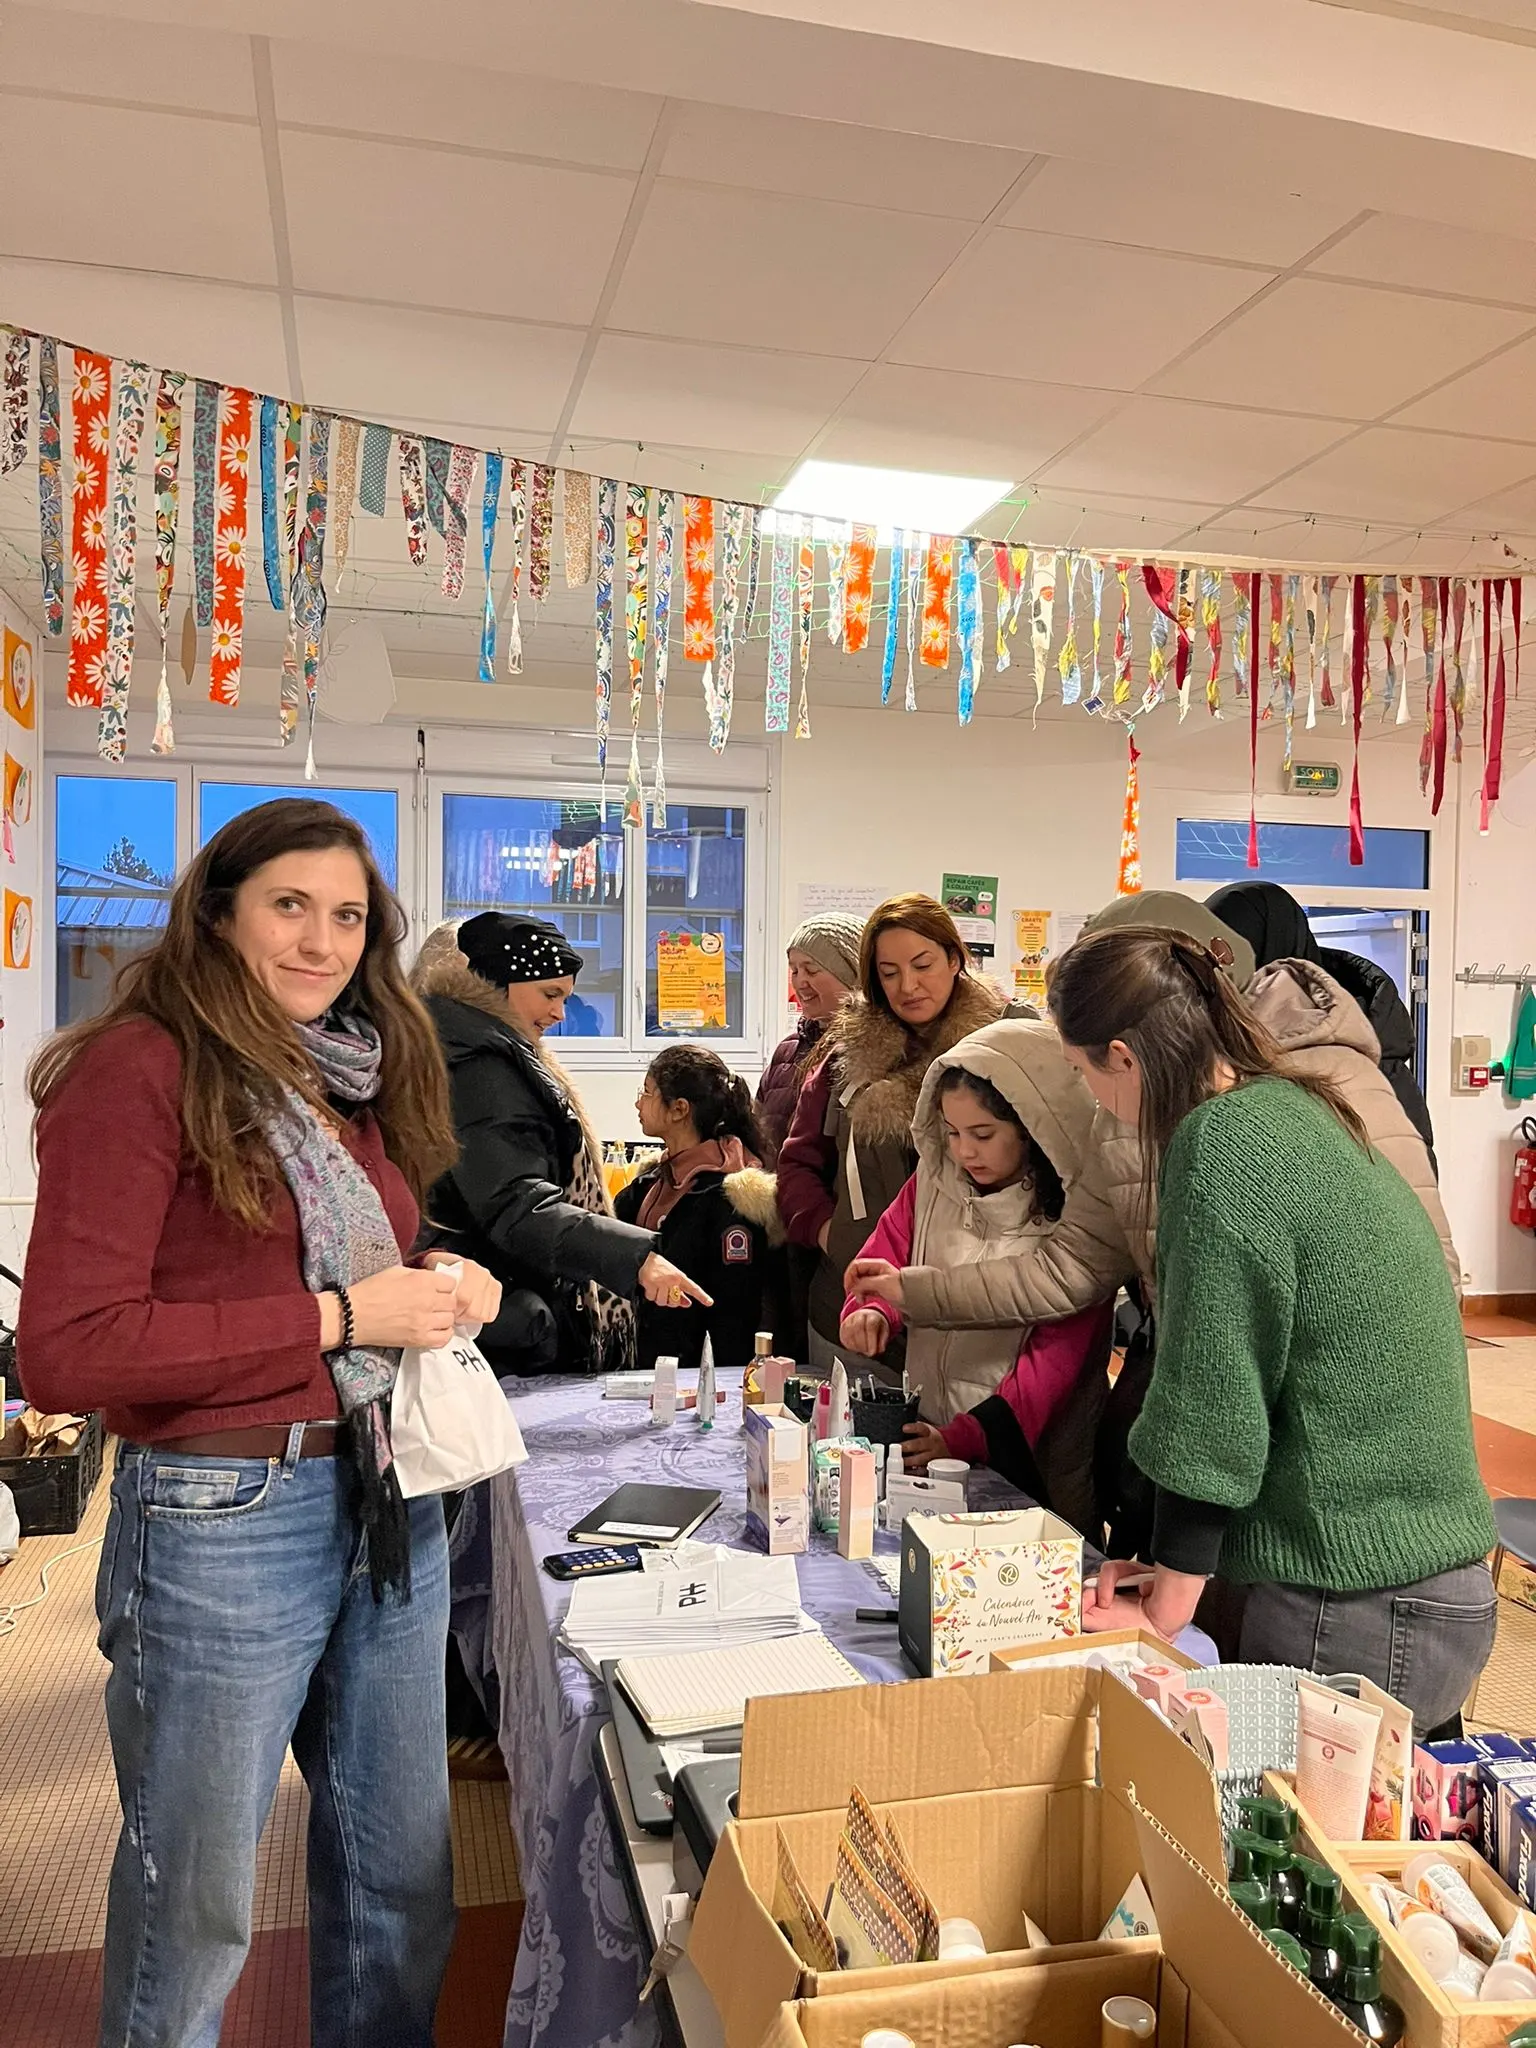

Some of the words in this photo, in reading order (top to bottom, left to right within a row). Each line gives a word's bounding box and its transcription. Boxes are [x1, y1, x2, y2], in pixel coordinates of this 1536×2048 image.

[983, 1597, 1035, 1612] Calendrier
[989, 1611, 1024, 1628] Nouvel
[1023, 1609, 1043, 1624] An
[850, 1828, 875, 1872] Binder
[840, 1880, 861, 1921] Binder
